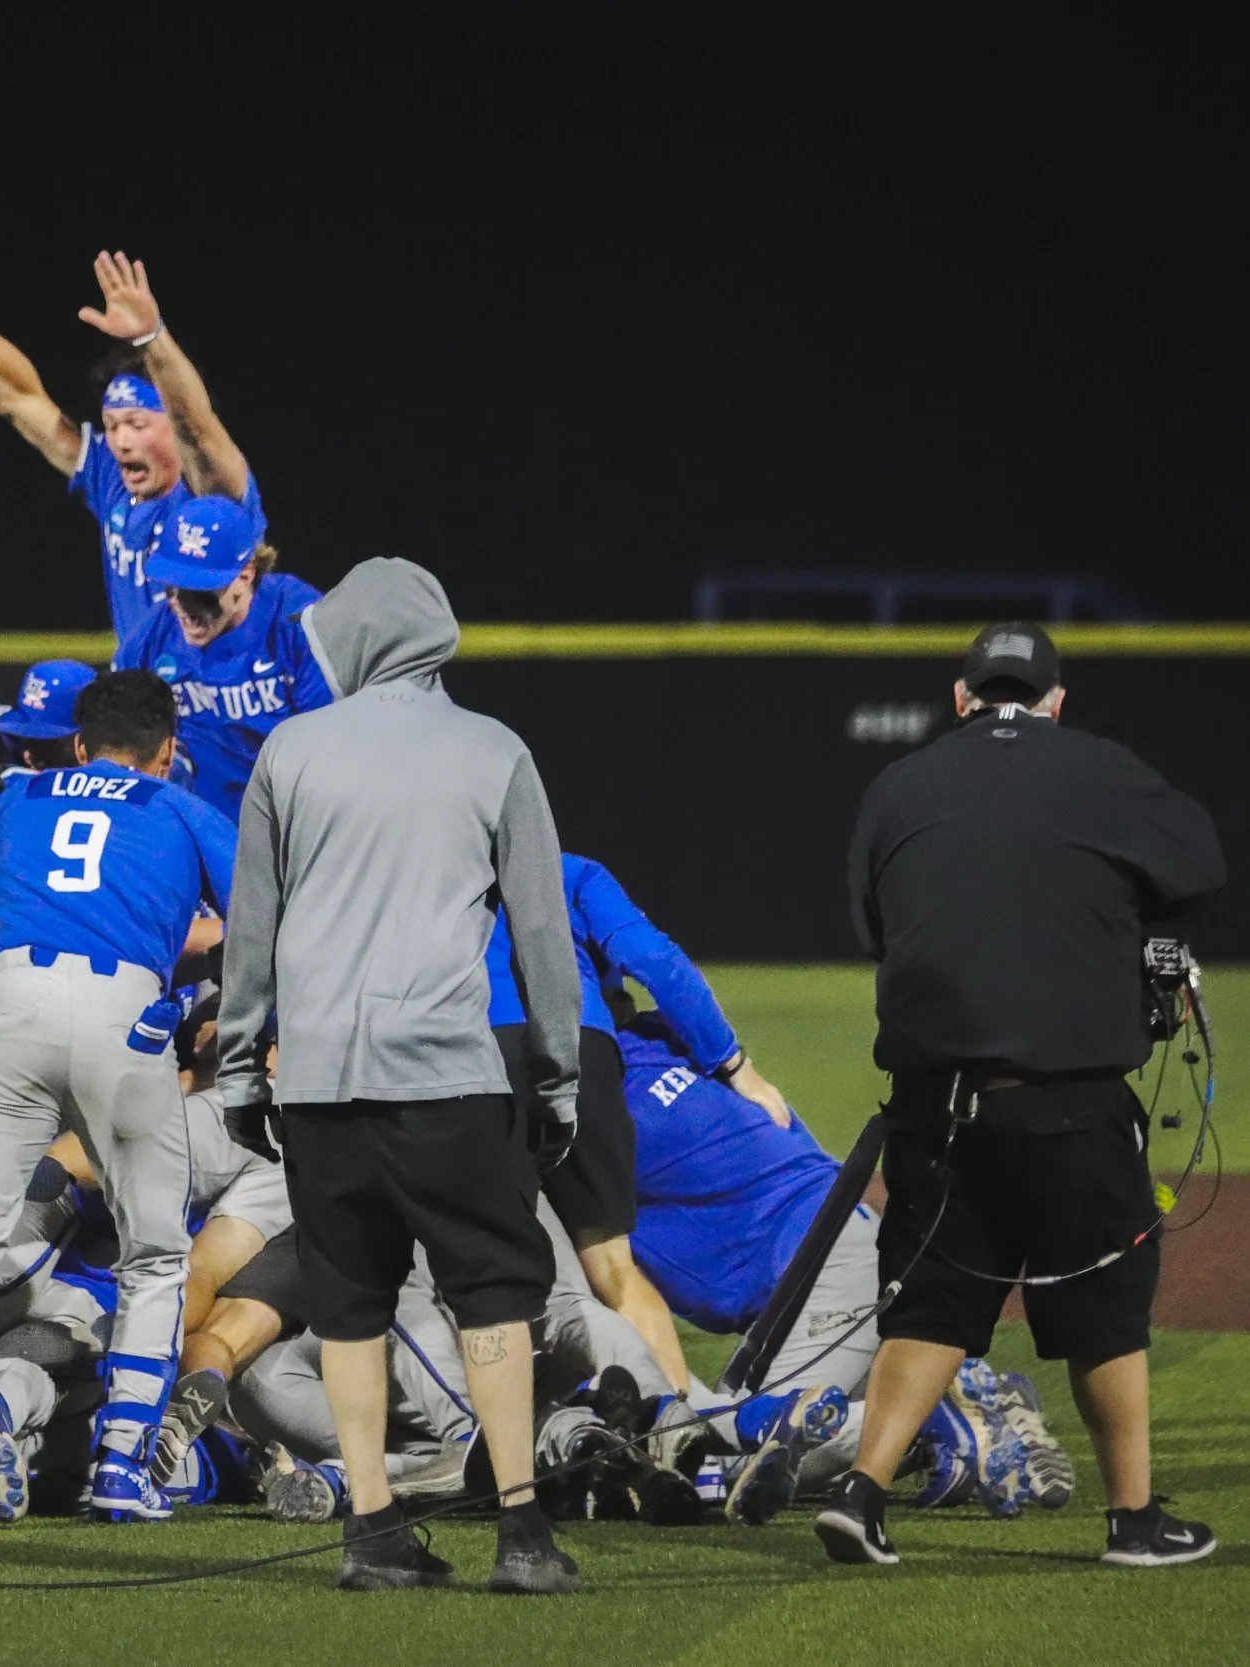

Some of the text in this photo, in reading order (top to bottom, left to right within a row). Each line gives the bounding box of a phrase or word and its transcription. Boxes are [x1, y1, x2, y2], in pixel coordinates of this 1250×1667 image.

[171, 675, 296, 721] ENTUCK
[51, 771, 139, 801] LOPEZ
[46, 809, 112, 893] 9
